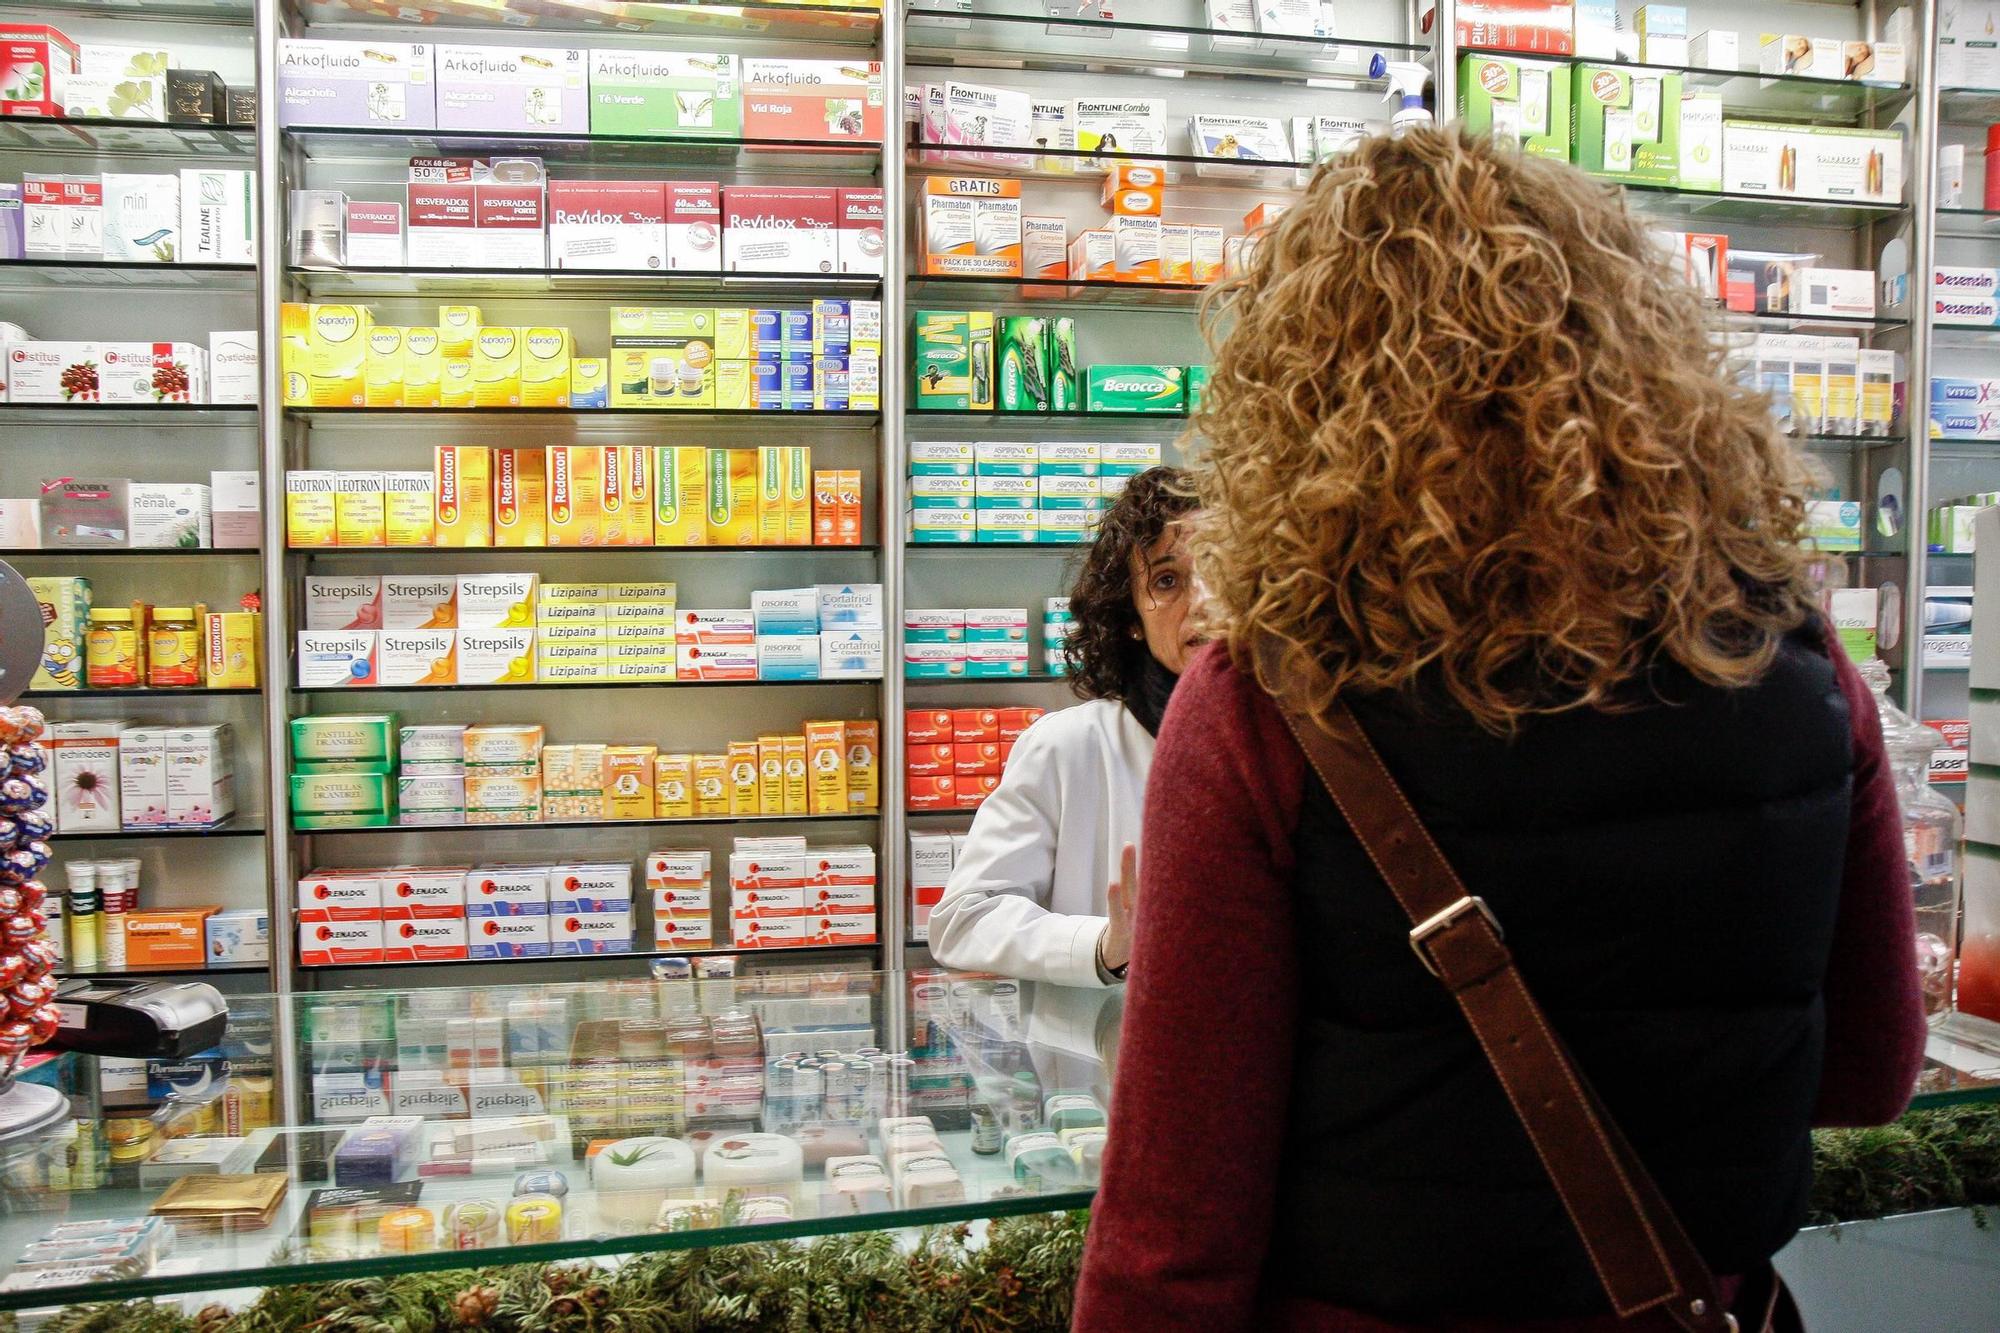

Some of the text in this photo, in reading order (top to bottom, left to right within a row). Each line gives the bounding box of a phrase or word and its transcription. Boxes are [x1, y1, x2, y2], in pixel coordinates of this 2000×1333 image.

[411, 45, 424, 55] 10
[285, 53, 360, 68] Arkofluido
[566, 51, 579, 61] 20
[717, 55, 730, 65] 20
[445, 58, 517, 73] Arkofluido
[599, 63, 669, 77] Arkofluido
[868, 63, 880, 73] 10
[752, 72, 821, 86] Arkofluido
[285, 88, 337, 98] Alcachofa
[950, 86, 997, 102] FRONTLINE
[614, 95, 645, 105] Verde
[751, 104, 792, 114] Vid Roja
[1032, 105, 1065, 114] NTLINE
[1077, 102, 1150, 113] FRONTLINE Combo
[1199, 116, 1242, 124] FRONTLINE
[1320, 118, 1366, 129] FRONTLINE
[414, 168, 444, 178] 50%
[949, 180, 1001, 194] GRATIS
[123, 193, 147, 209] mini
[416, 198, 469, 206] RESVERADOX
[484, 200, 536, 208] RESVERADOX
[931, 199, 971, 209] Pharmaton
[978, 201, 1018, 211] Pharmaton
[351, 213, 396, 221] RESVERADOX
[1120, 217, 1158, 228] Pharmaton
[199, 208, 211, 253] TEALINE
[1026, 221, 1063, 231] Pharmaton
[1161, 227, 1188, 235] Pharmaton
[1193, 229, 1221, 237] Pharmaton
[944, 258, 961, 266] PACK
[1936, 272, 1992, 287] Desensin
[818, 306, 840, 314] BION
[1936, 301, 1992, 315] Desensin
[318, 316, 354, 327] Supradyn
[371, 335, 398, 344] Supradyn
[408, 336, 435, 345] Supradyn
[480, 336, 512, 347] Supradyn
[528, 337, 560, 347] Supradyn
[12, 350, 60, 363] Cistitus
[105, 351, 150, 364] Cistitus
[216, 353, 257, 364] Cysticlea
[754, 366, 773, 374] BION
[786, 366, 805, 374] BION
[818, 361, 841, 370] BION
[1007, 358, 1016, 405] Berocca
[1103, 379, 1166, 393] Berocca
[607, 451, 617, 494] Redoxon
[635, 450, 643, 486] Redoxon
[442, 451, 454, 503] Redoxon
[501, 453, 513, 505] Redoxon
[555, 451, 567, 503] Redoxon
[663, 450, 673, 506] RedoxComplex
[716, 452, 725, 507] RedoxComplex
[289, 479, 331, 492] LEOTRON
[338, 480, 380, 492] LEOTRON
[387, 479, 430, 491] LEOTRON
[133, 497, 176, 508] Renale
[312, 584, 373, 600] Strepsils
[388, 583, 448, 599] Strepsils
[464, 583, 524, 598] Strepsils
[551, 587, 598, 599] Lizipaina
[619, 586, 666, 598] Lizipaina
[823, 594, 871, 603] Cortafriol
[548, 607, 595, 618] Lizipaina
[617, 606, 664, 618] Lizipaina
[549, 627, 596, 638] Lizipaina
[617, 626, 664, 638] Lizipaina
[212, 615, 221, 662] Redoxitos
[305, 639, 366, 654] Strepsils
[386, 637, 446, 654] Strepsils
[464, 637, 524, 653] Strepsils
[830, 640, 880, 650] Cortafriol
[550, 646, 597, 658] Lizipaina
[618, 645, 665, 657] Lizipaina
[550, 666, 596, 678] Lizipaina
[619, 664, 666, 676] Lizipaina
[315, 731, 365, 739] PASTILLAS
[60, 750, 111, 759] echinácea
[1929, 759, 1966, 770] Lacer
[915, 850, 949, 859] Bisolvon
[487, 882, 532, 893] FRENADOL
[571, 878, 615, 890] FRENADOL
[320, 887, 367, 897] FRENADOL
[403, 885, 450, 896] FRENADOL
[127, 921, 182, 931] CARNITINA
[489, 923, 535, 934] FRENADOL
[572, 920, 616, 931] FRENADOL
[322, 929, 368, 939] FRENADOL
[406, 926, 453, 937] FRENADOL
